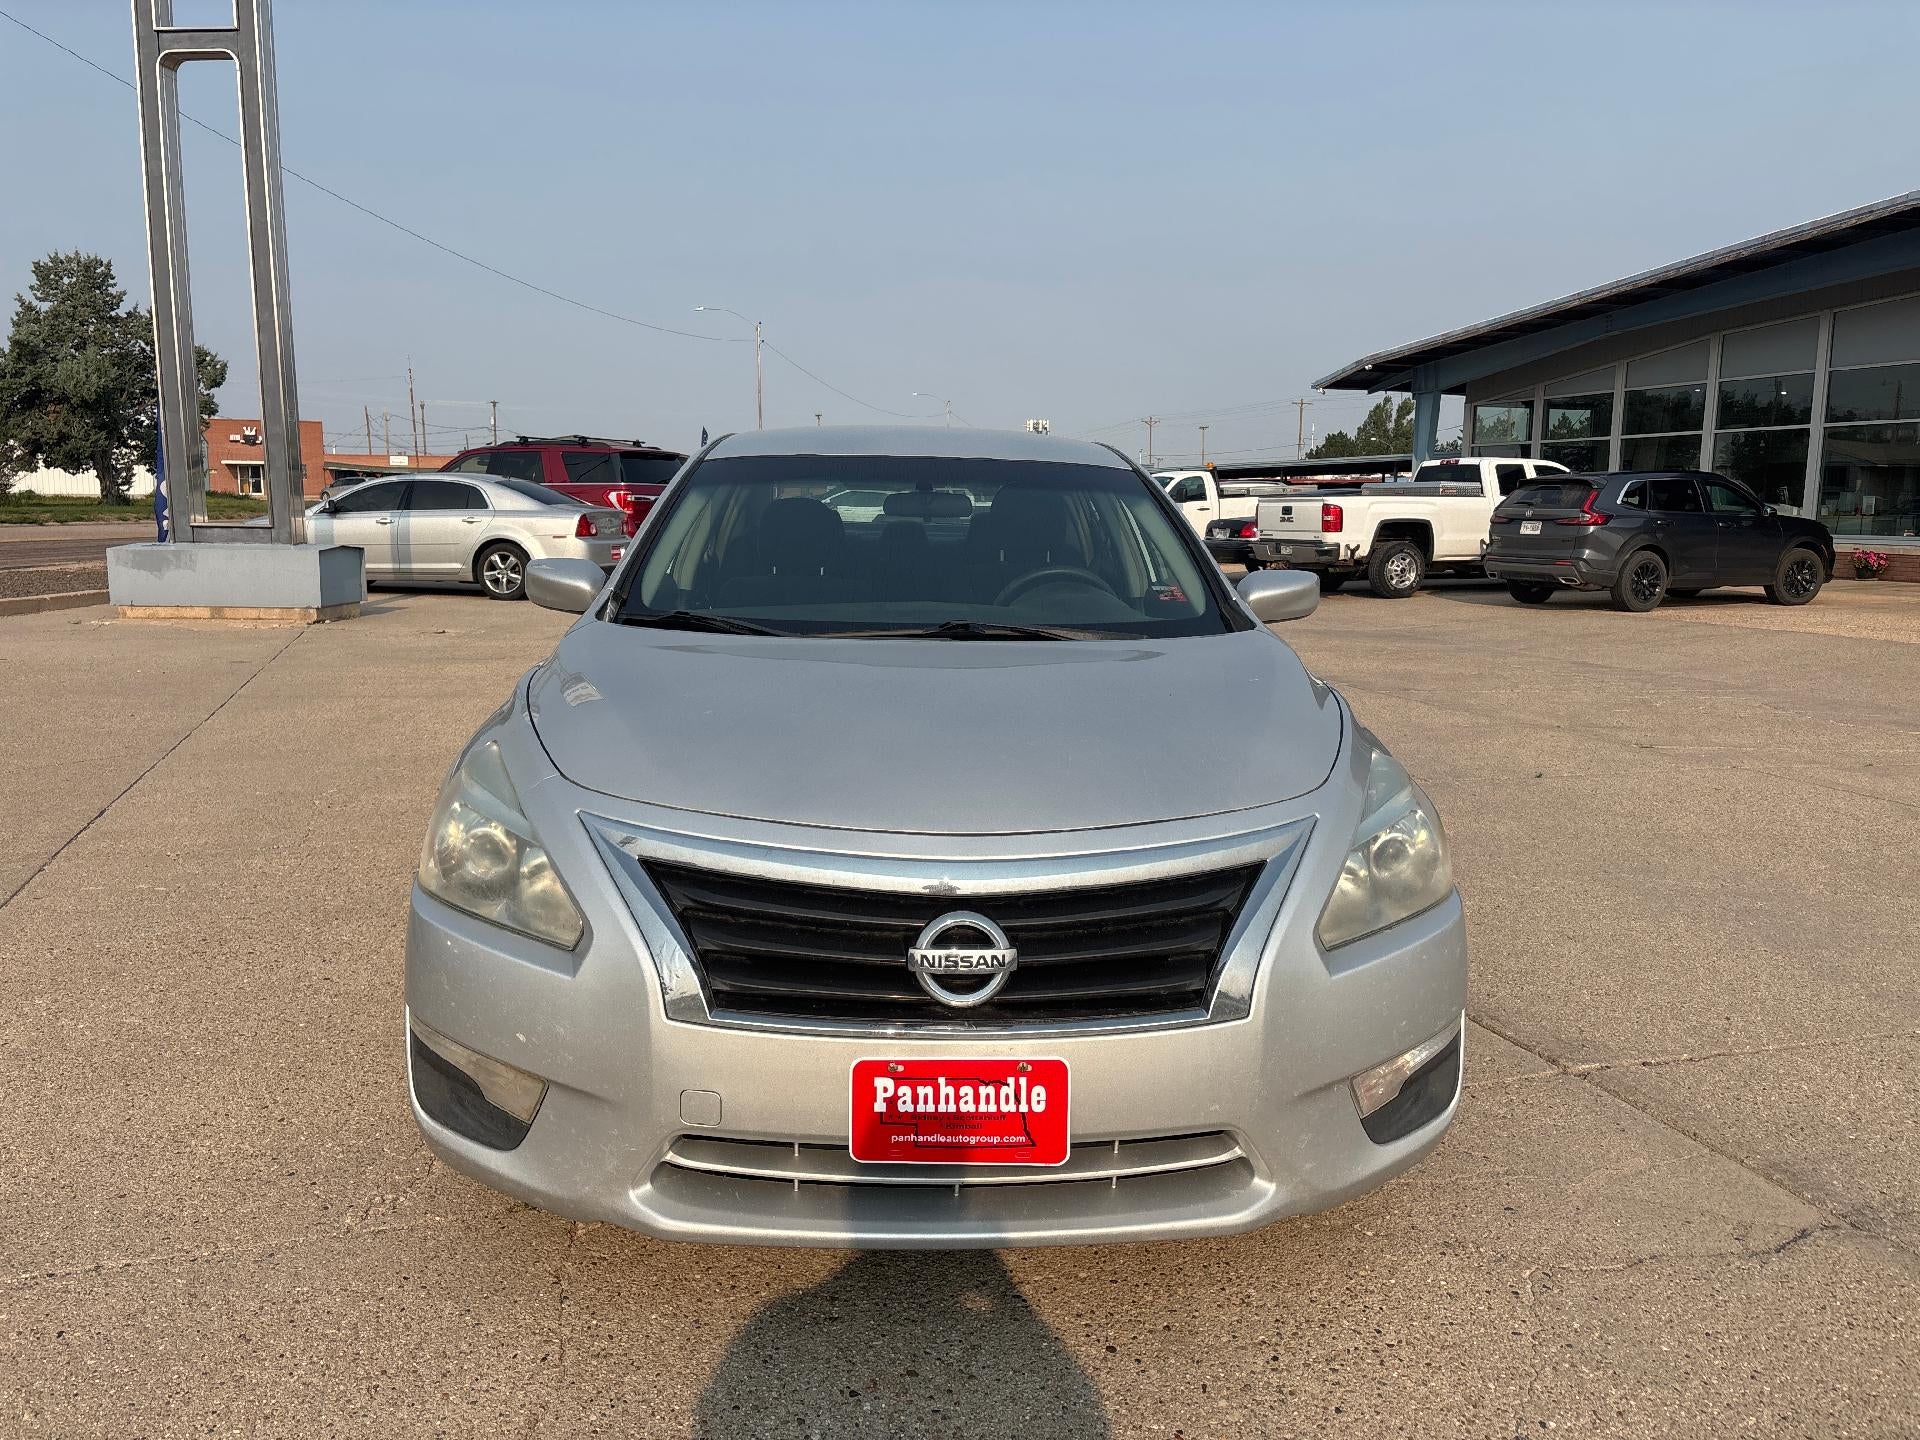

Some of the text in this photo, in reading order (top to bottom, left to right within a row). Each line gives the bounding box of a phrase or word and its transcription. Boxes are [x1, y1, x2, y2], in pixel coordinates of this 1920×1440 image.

[919, 953, 1006, 969] NISSAN
[873, 1076, 1047, 1113] Panhandle
[891, 1133, 1026, 1145] panhandleautogroup.com
